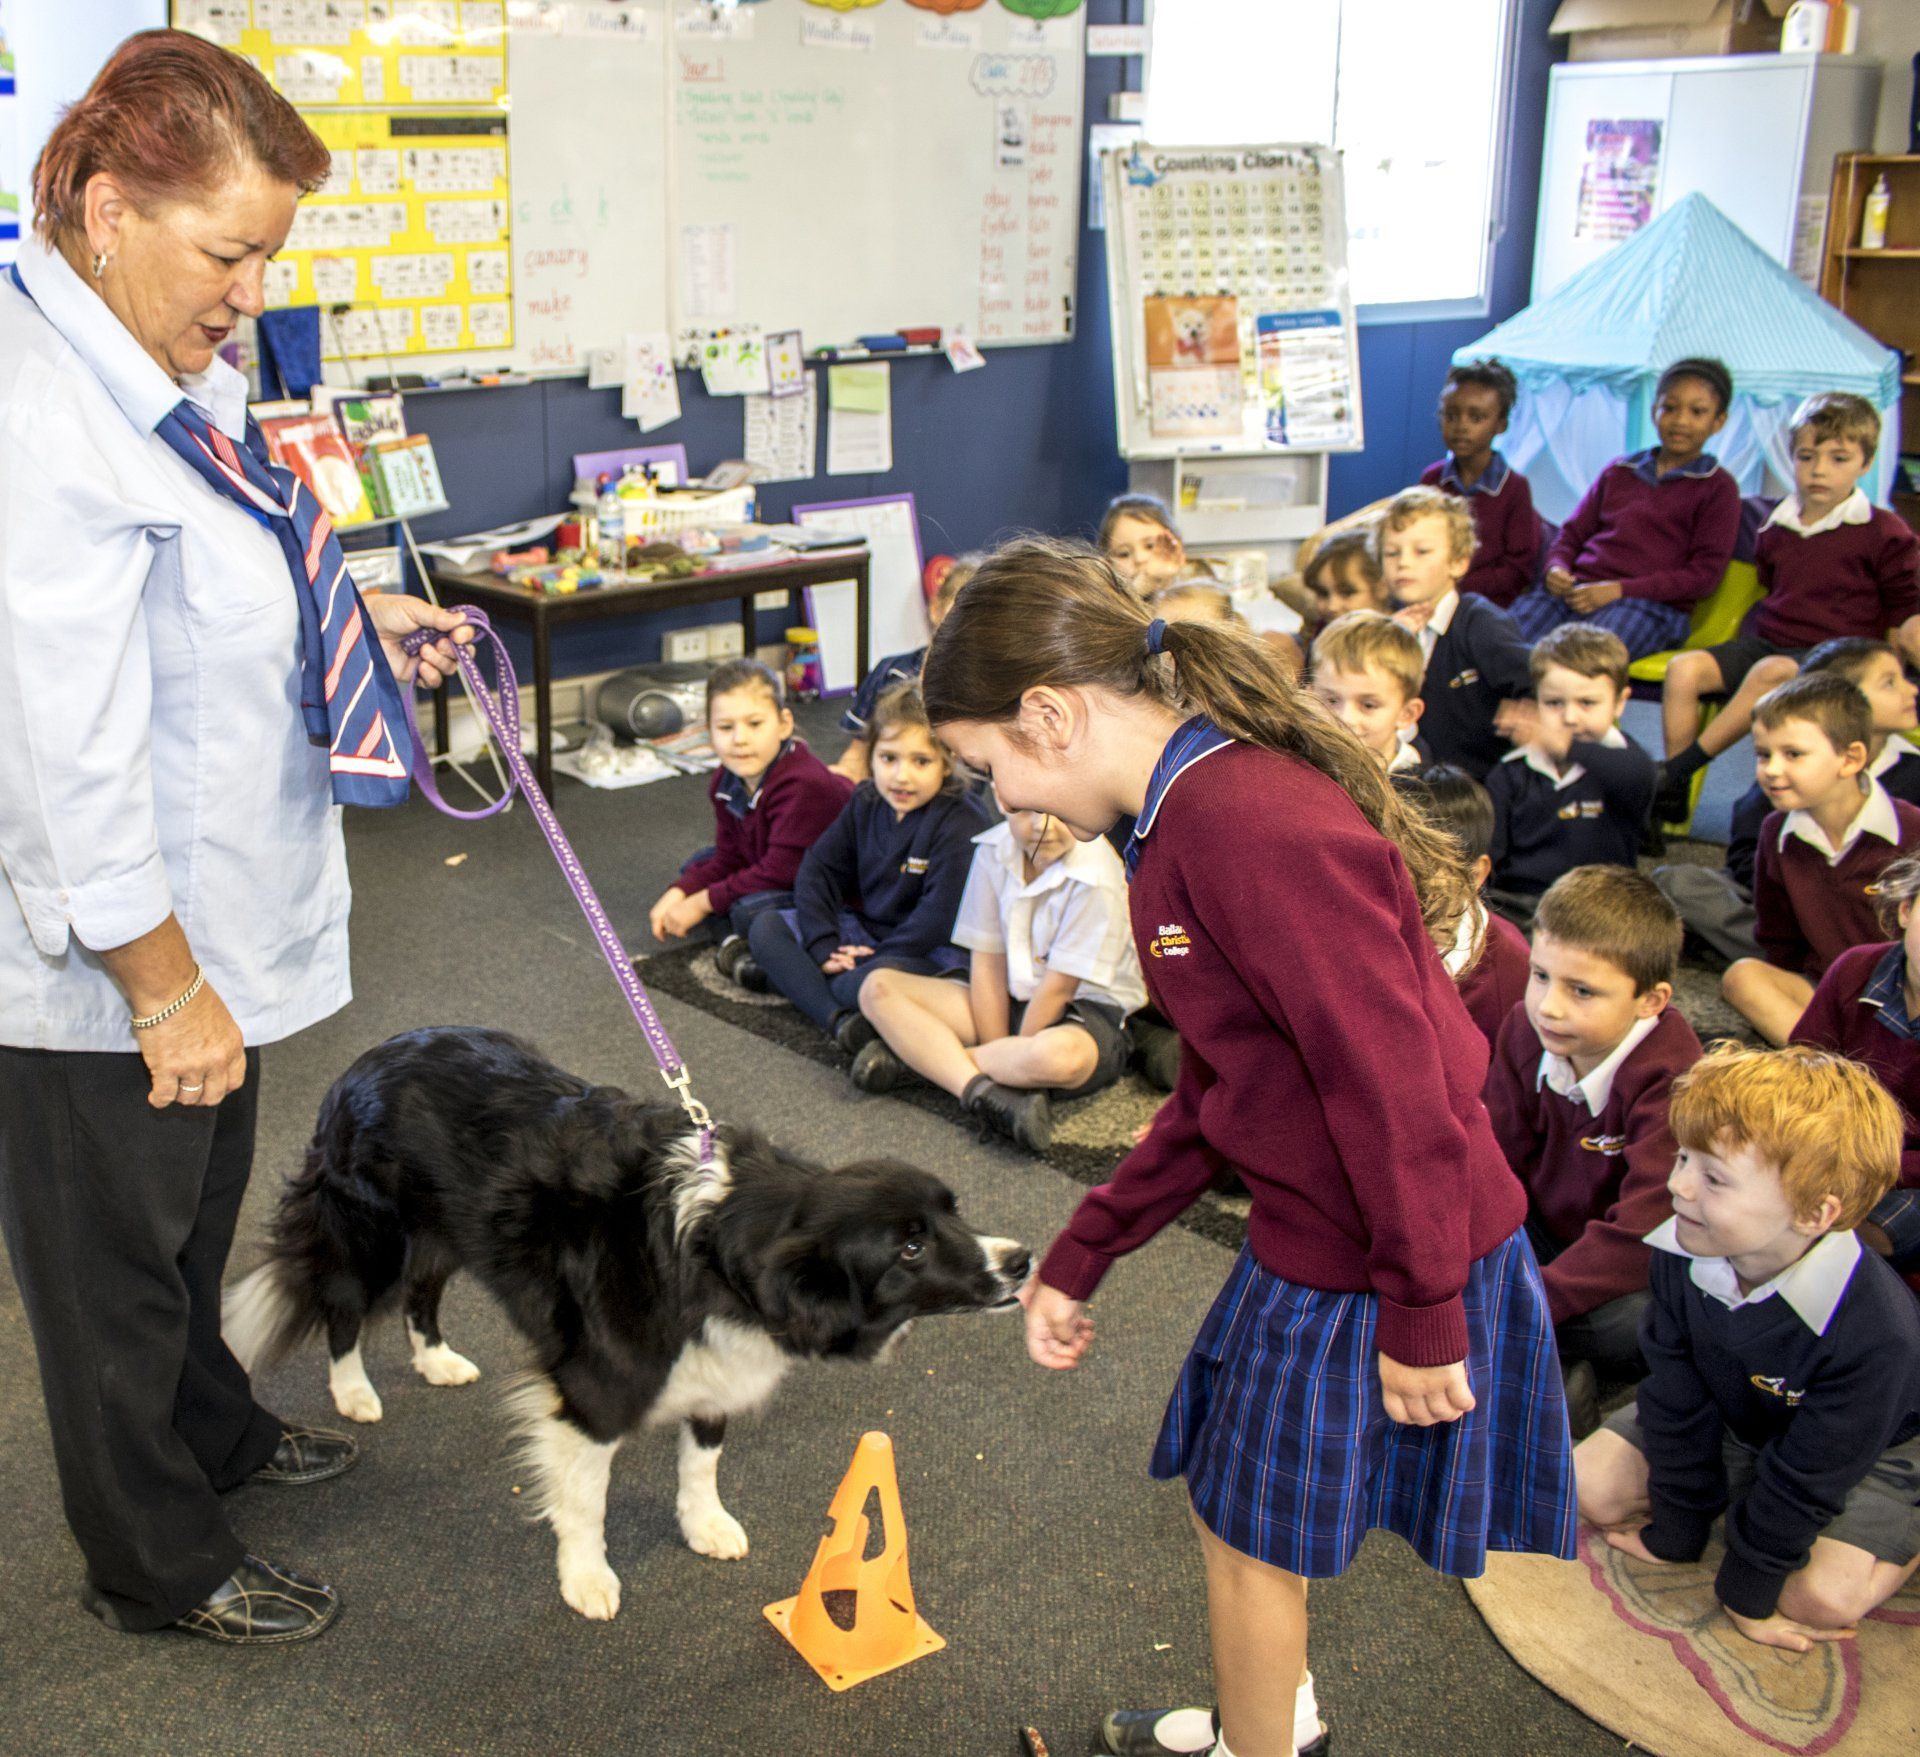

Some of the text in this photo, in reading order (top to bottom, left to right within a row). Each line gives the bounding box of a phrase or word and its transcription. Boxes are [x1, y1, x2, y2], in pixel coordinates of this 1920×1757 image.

[1154, 151, 1293, 173] Counting Chart
[527, 289, 571, 316] make
[1163, 946, 1190, 957] College
